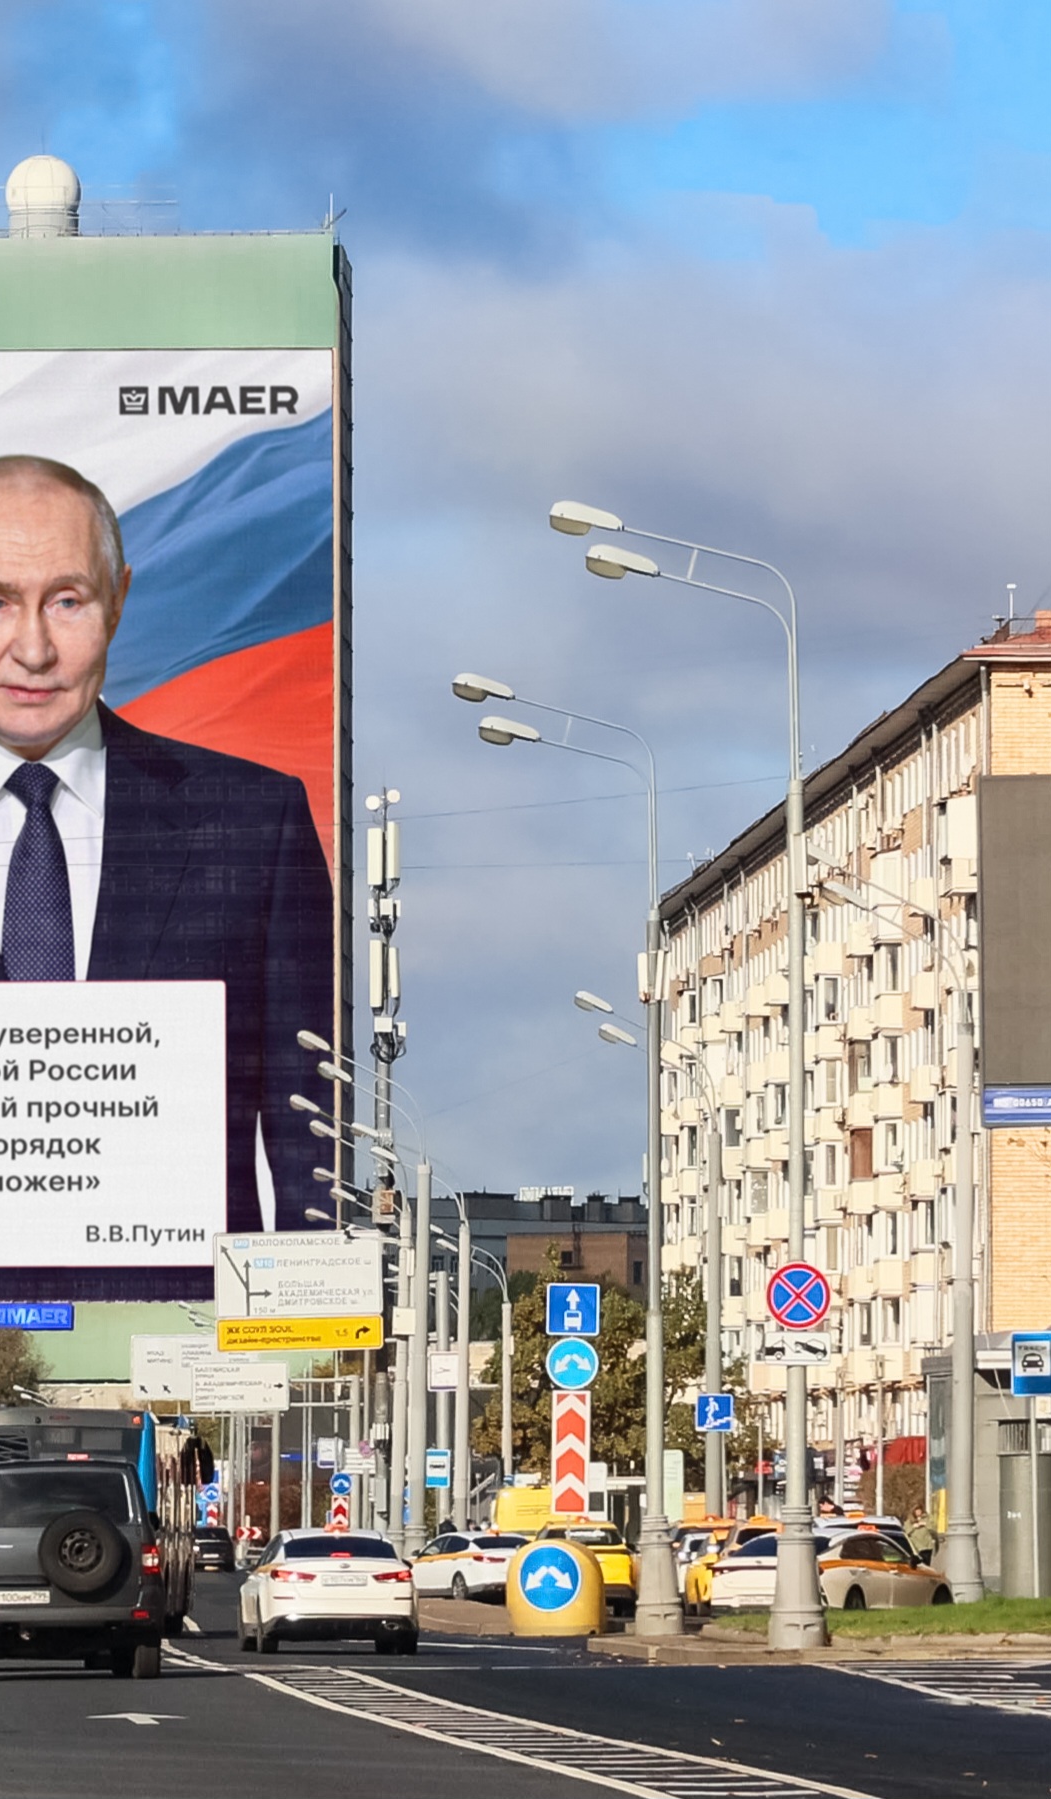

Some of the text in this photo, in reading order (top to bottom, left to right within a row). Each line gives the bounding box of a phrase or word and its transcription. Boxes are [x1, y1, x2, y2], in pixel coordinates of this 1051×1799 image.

[158, 385, 299, 415] MAER
[29, 1059, 137, 1081] России
[26, 1096, 159, 1123] прочный
[86, 1225, 206, 1246] В.В.Путин
[7, 1308, 68, 1324] MAER
